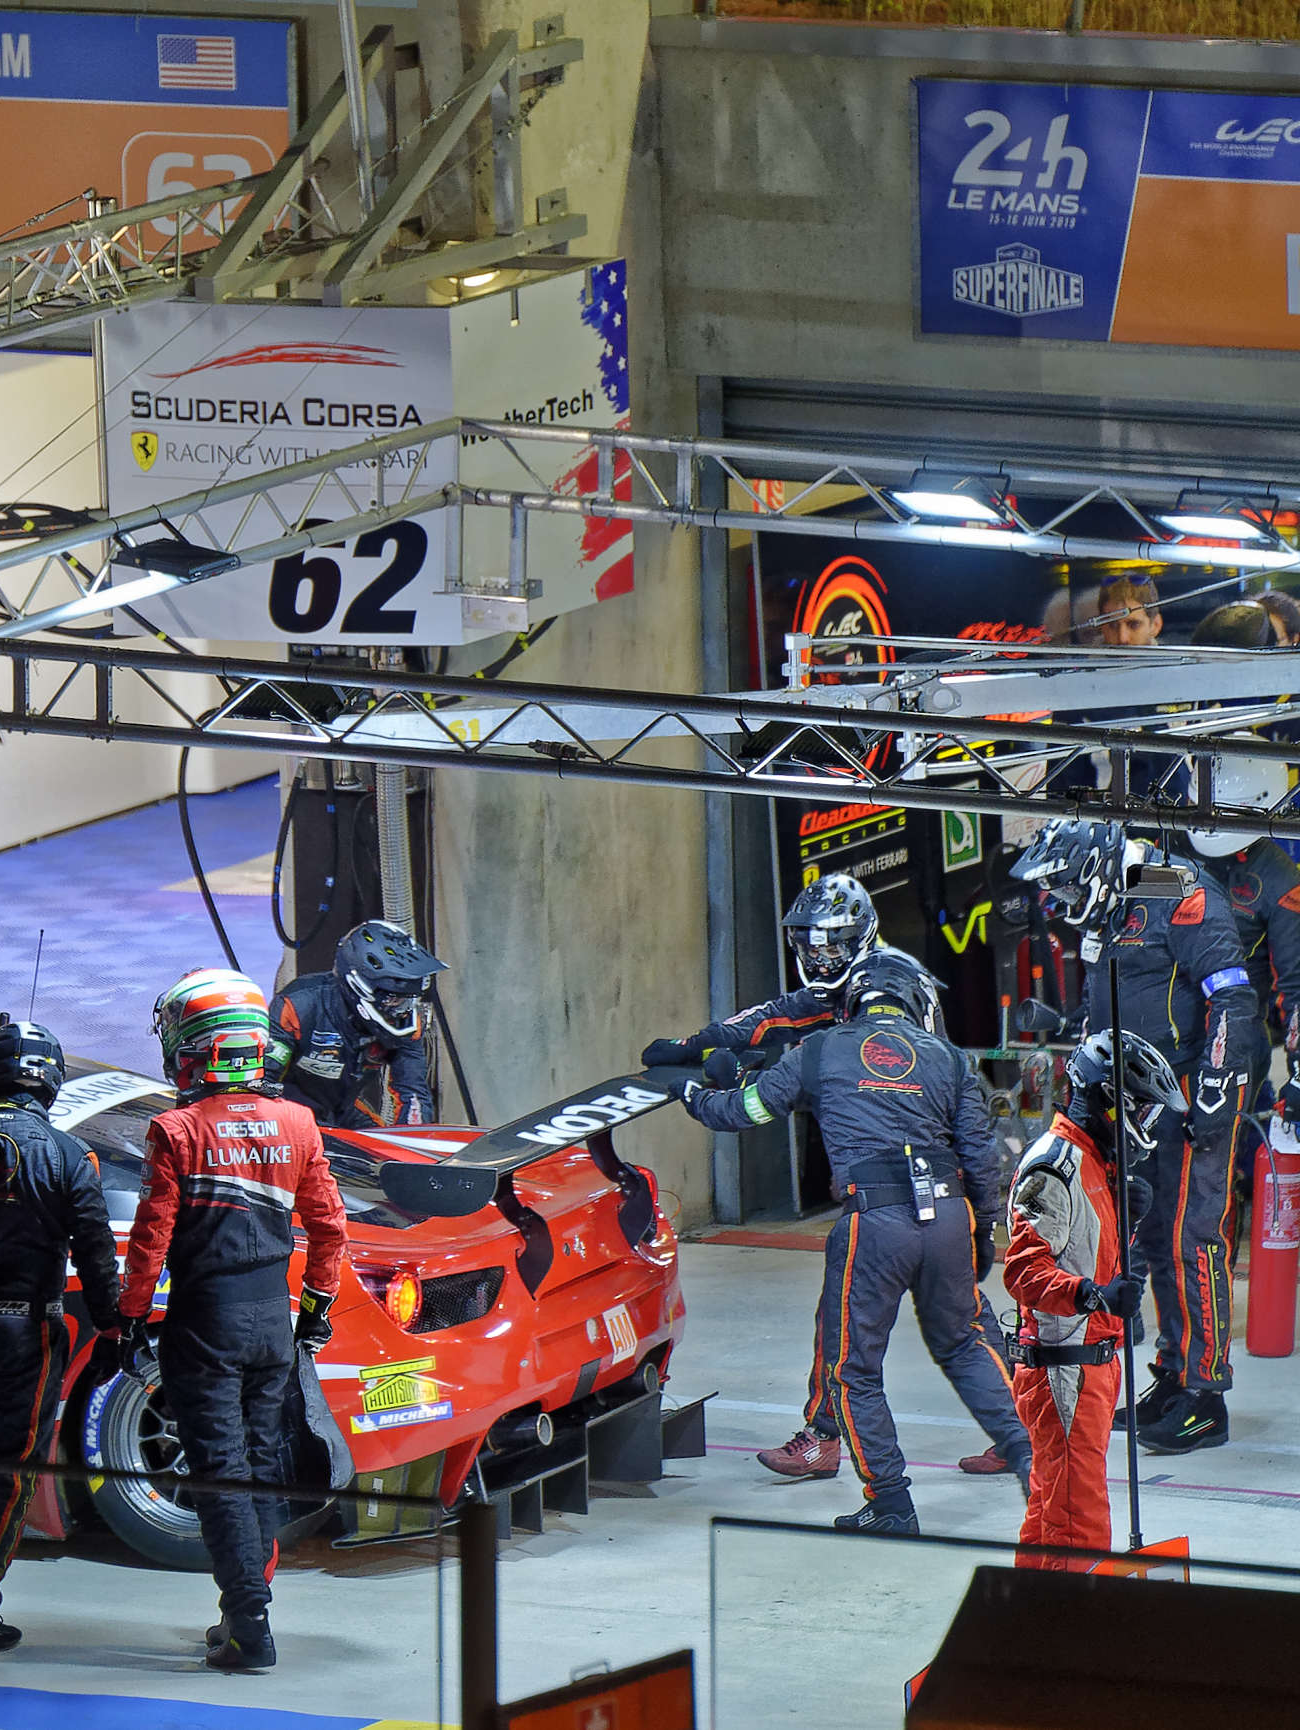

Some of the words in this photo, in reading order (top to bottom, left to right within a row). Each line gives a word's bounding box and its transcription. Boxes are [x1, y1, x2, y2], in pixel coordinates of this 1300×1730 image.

[952, 110, 1088, 190] 24h
[947, 188, 986, 210] LE
[991, 191, 1080, 214] MANS
[955, 261, 1084, 314] SUPERFINALE
[130, 391, 293, 426] SCUDERIA
[302, 398, 423, 427] CORSA
[165, 441, 253, 467] RACING
[268, 517, 428, 635] 62
[216, 1120, 279, 1138] CRESSONI
[515, 1085, 669, 1145] PECOM
[206, 1145, 292, 1167] LUMAIKE
[608, 1311, 635, 1355] AM
